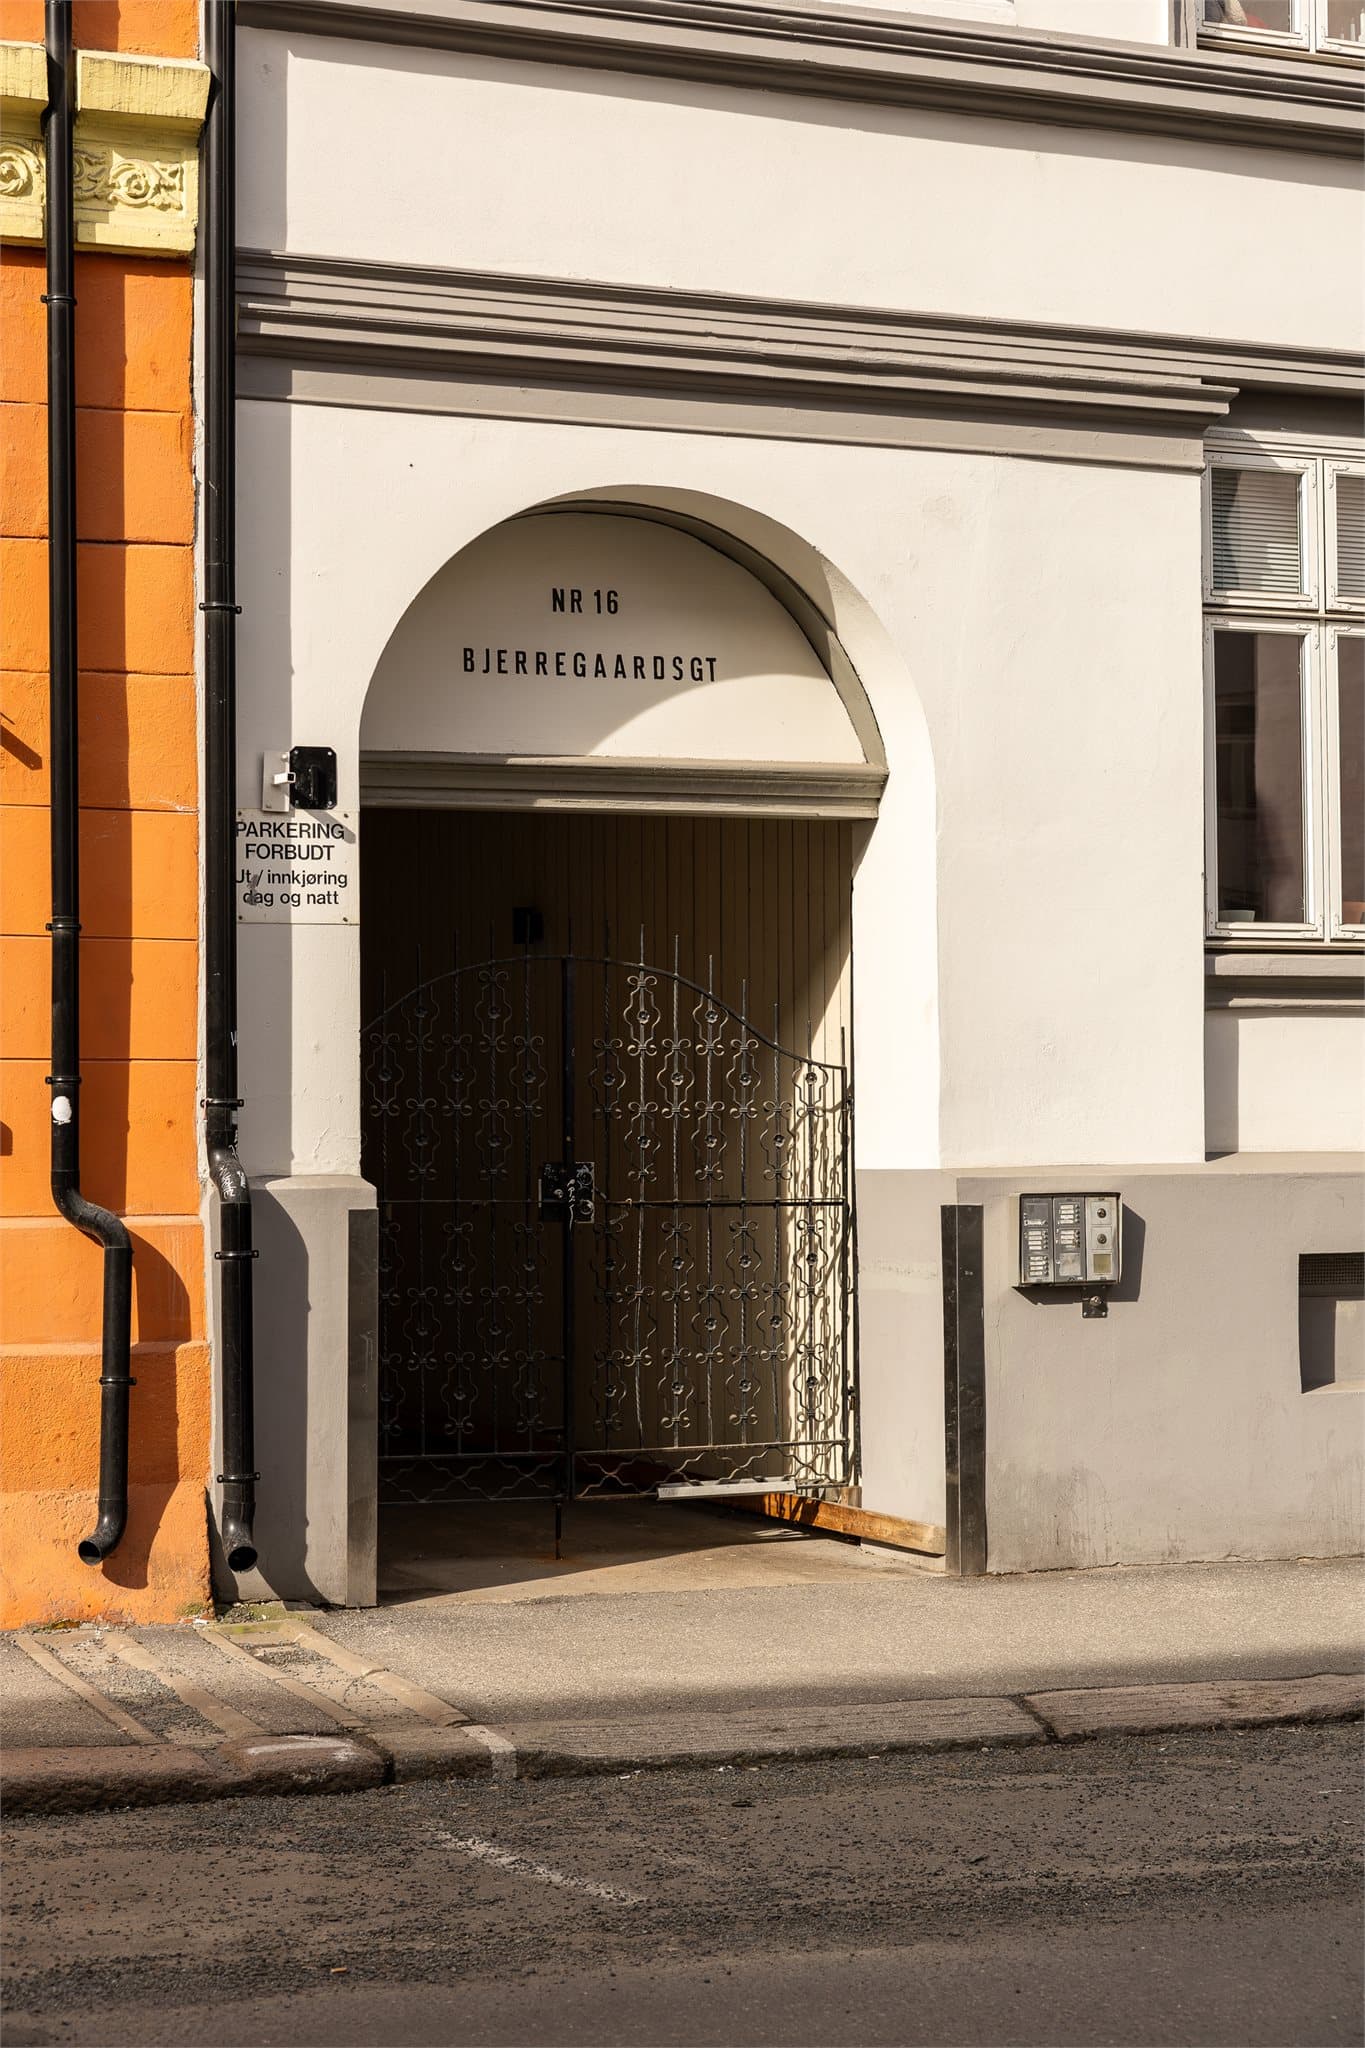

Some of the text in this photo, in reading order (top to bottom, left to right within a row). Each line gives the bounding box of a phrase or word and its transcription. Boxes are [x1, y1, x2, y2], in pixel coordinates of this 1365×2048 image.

[551, 588, 619, 615] NR 16
[463, 647, 718, 682] BJERREGAARDSGT
[236, 821, 345, 840] PARKERING
[245, 843, 335, 860] FORBUDT
[267, 869, 348, 888] innkjøring
[243, 890, 339, 907] dag og natt
